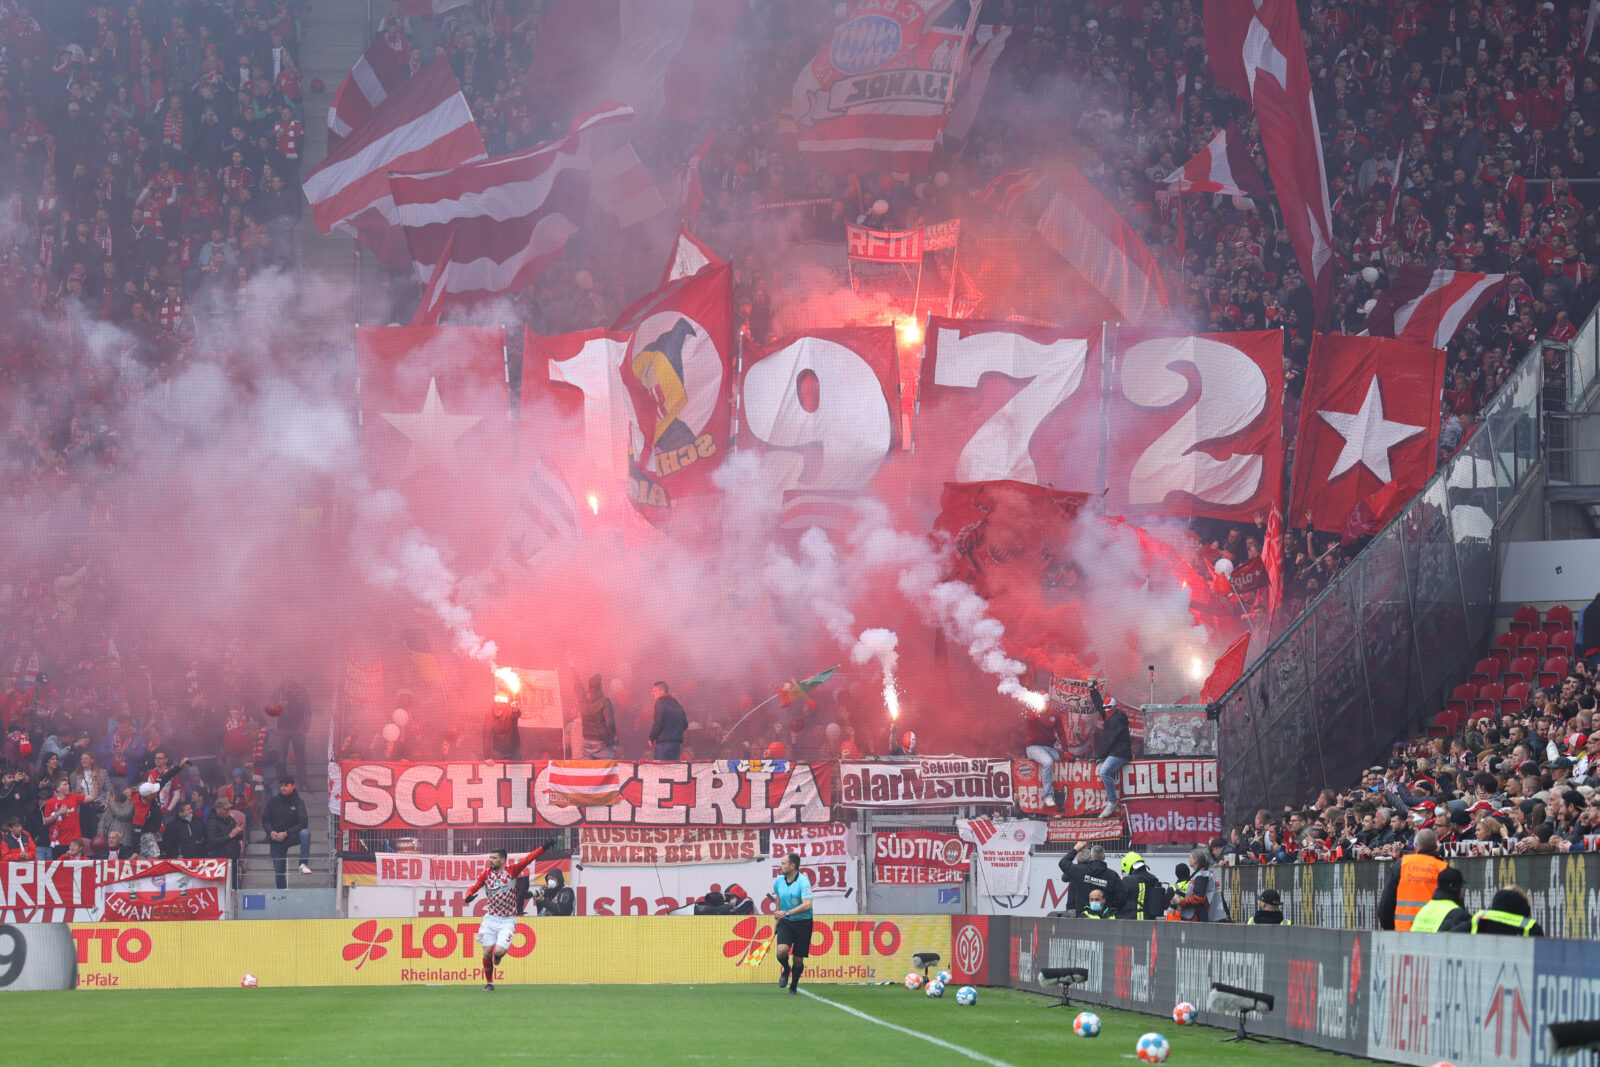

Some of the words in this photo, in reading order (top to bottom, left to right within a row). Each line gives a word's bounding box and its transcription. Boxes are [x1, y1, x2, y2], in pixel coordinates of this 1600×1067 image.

[921, 761, 968, 775] Sektion
[1122, 762, 1218, 795] COLEGIO
[773, 826, 803, 840] WIR
[807, 823, 846, 839] SIND
[1130, 810, 1223, 833] Rhoibazis
[581, 828, 758, 844] AUSGESPERRTE
[1050, 832, 1077, 840] IMMER
[581, 845, 658, 864] IMMER
[664, 844, 703, 863] BEI
[708, 841, 756, 860] UNS
[772, 842, 806, 859] BEI
[811, 839, 847, 857] DIR
[381, 858, 423, 881] RED
[772, 866, 847, 888] OBI
[876, 866, 927, 883] LETZTE
[0, 861, 94, 907] RKT
[402, 923, 536, 959] LOTO
[808, 920, 902, 957] OTTO
[401, 967, 505, 982] Rheinland-Pflz
[780, 965, 876, 979] einland-Pfalz
